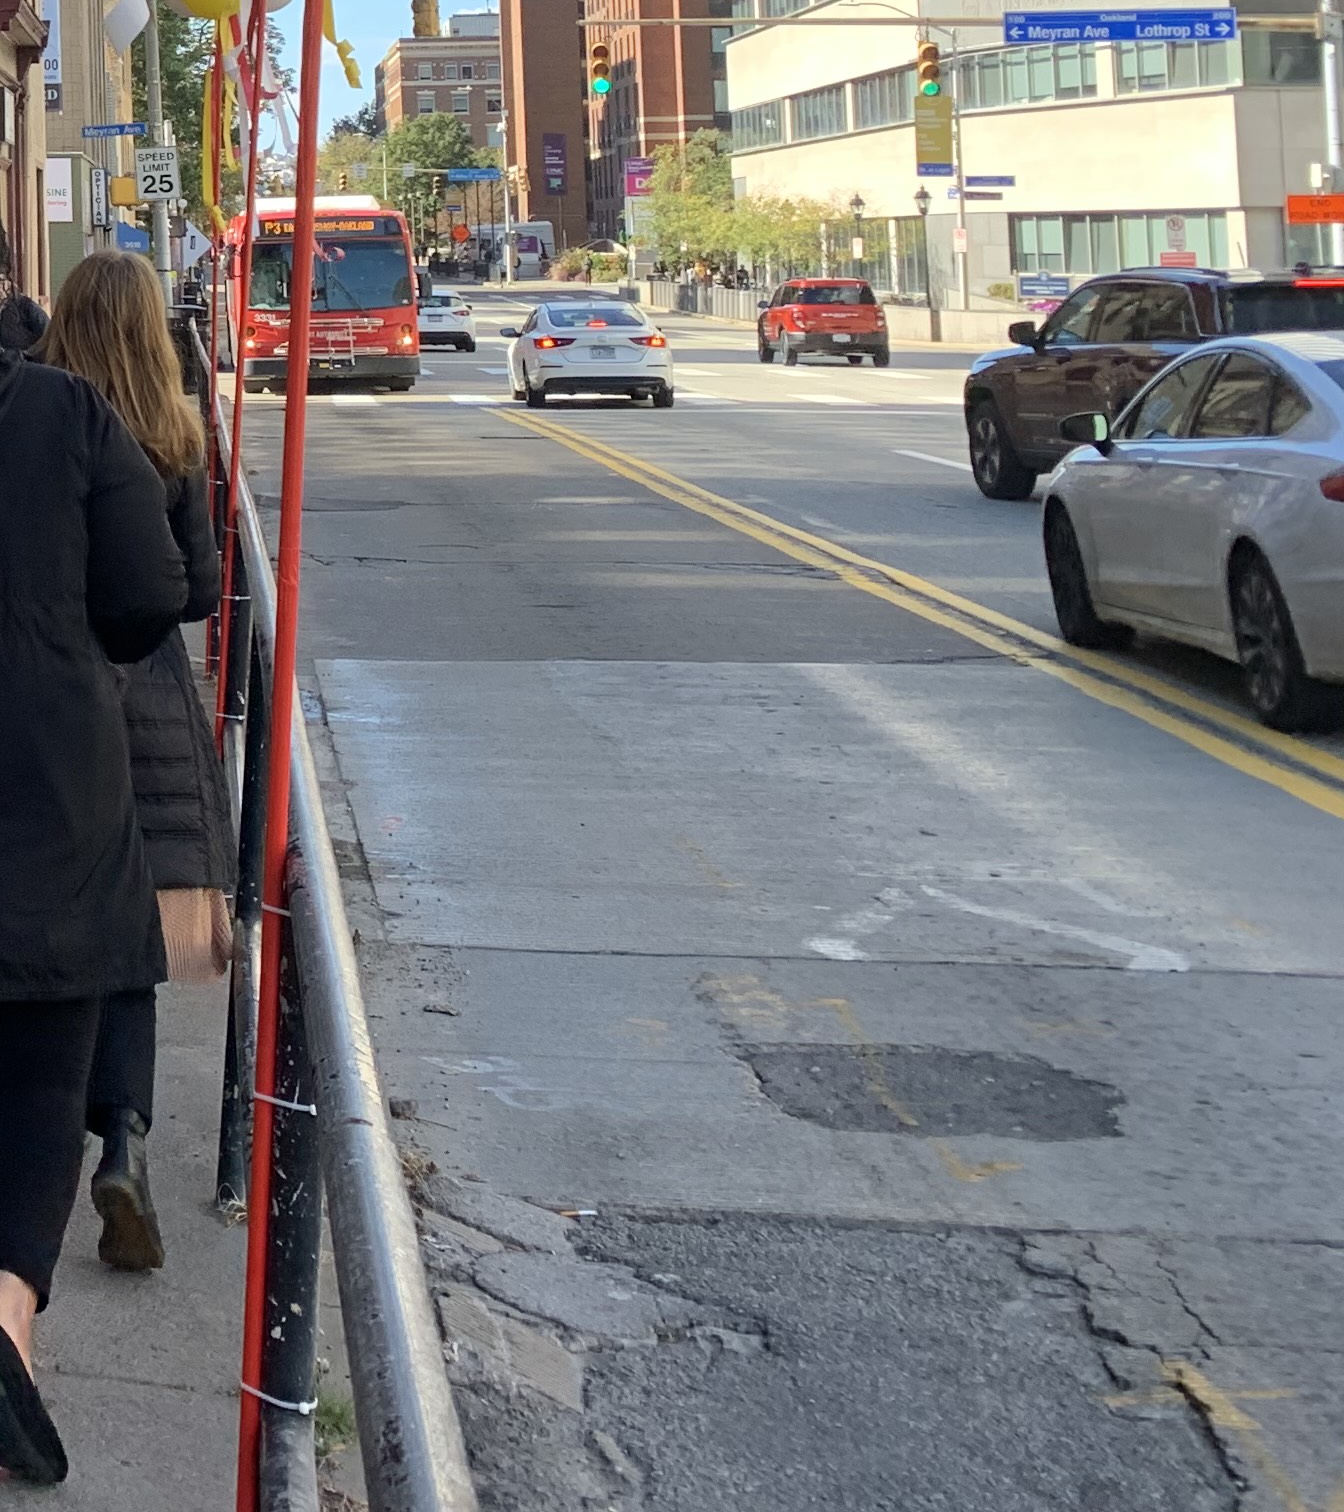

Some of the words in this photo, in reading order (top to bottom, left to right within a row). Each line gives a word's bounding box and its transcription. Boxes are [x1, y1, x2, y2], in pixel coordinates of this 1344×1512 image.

[1028, 25, 1079, 40] Meyran
[1082, 25, 1110, 38] Ave
[1136, 23, 1191, 39] Lothrop
[1194, 23, 1210, 36] St
[123, 124, 142, 135] Ave
[138, 151, 175, 162] SPEED
[142, 162, 170, 173] LIMIT
[142, 175, 174, 194] 25
[46, 188, 68, 197] SINE
[94, 171, 102, 224] OPTICIAN
